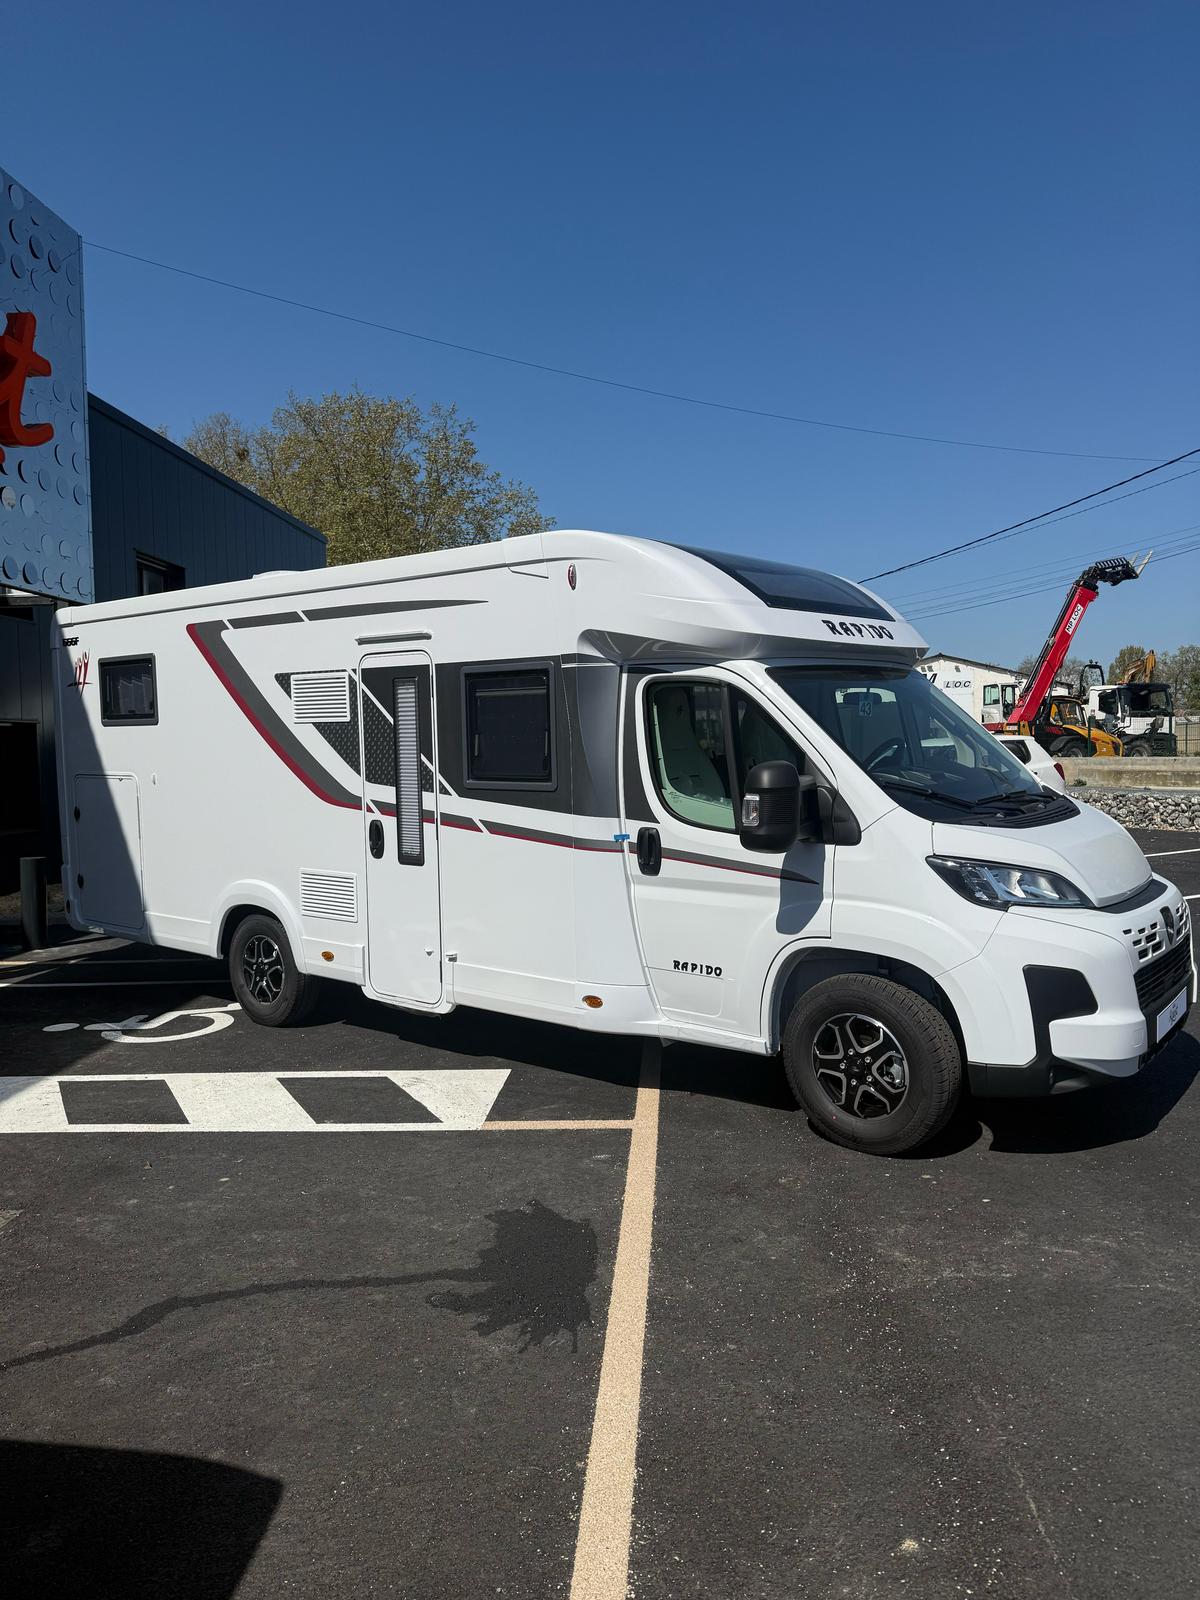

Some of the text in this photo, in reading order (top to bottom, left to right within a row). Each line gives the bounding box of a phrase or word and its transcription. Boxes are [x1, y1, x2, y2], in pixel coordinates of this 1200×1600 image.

[1072, 605, 1082, 621] LOC
[821, 619, 894, 640] RAPIDO
[945, 680, 971, 688] LOC
[673, 960, 722, 977] RAPIDO
